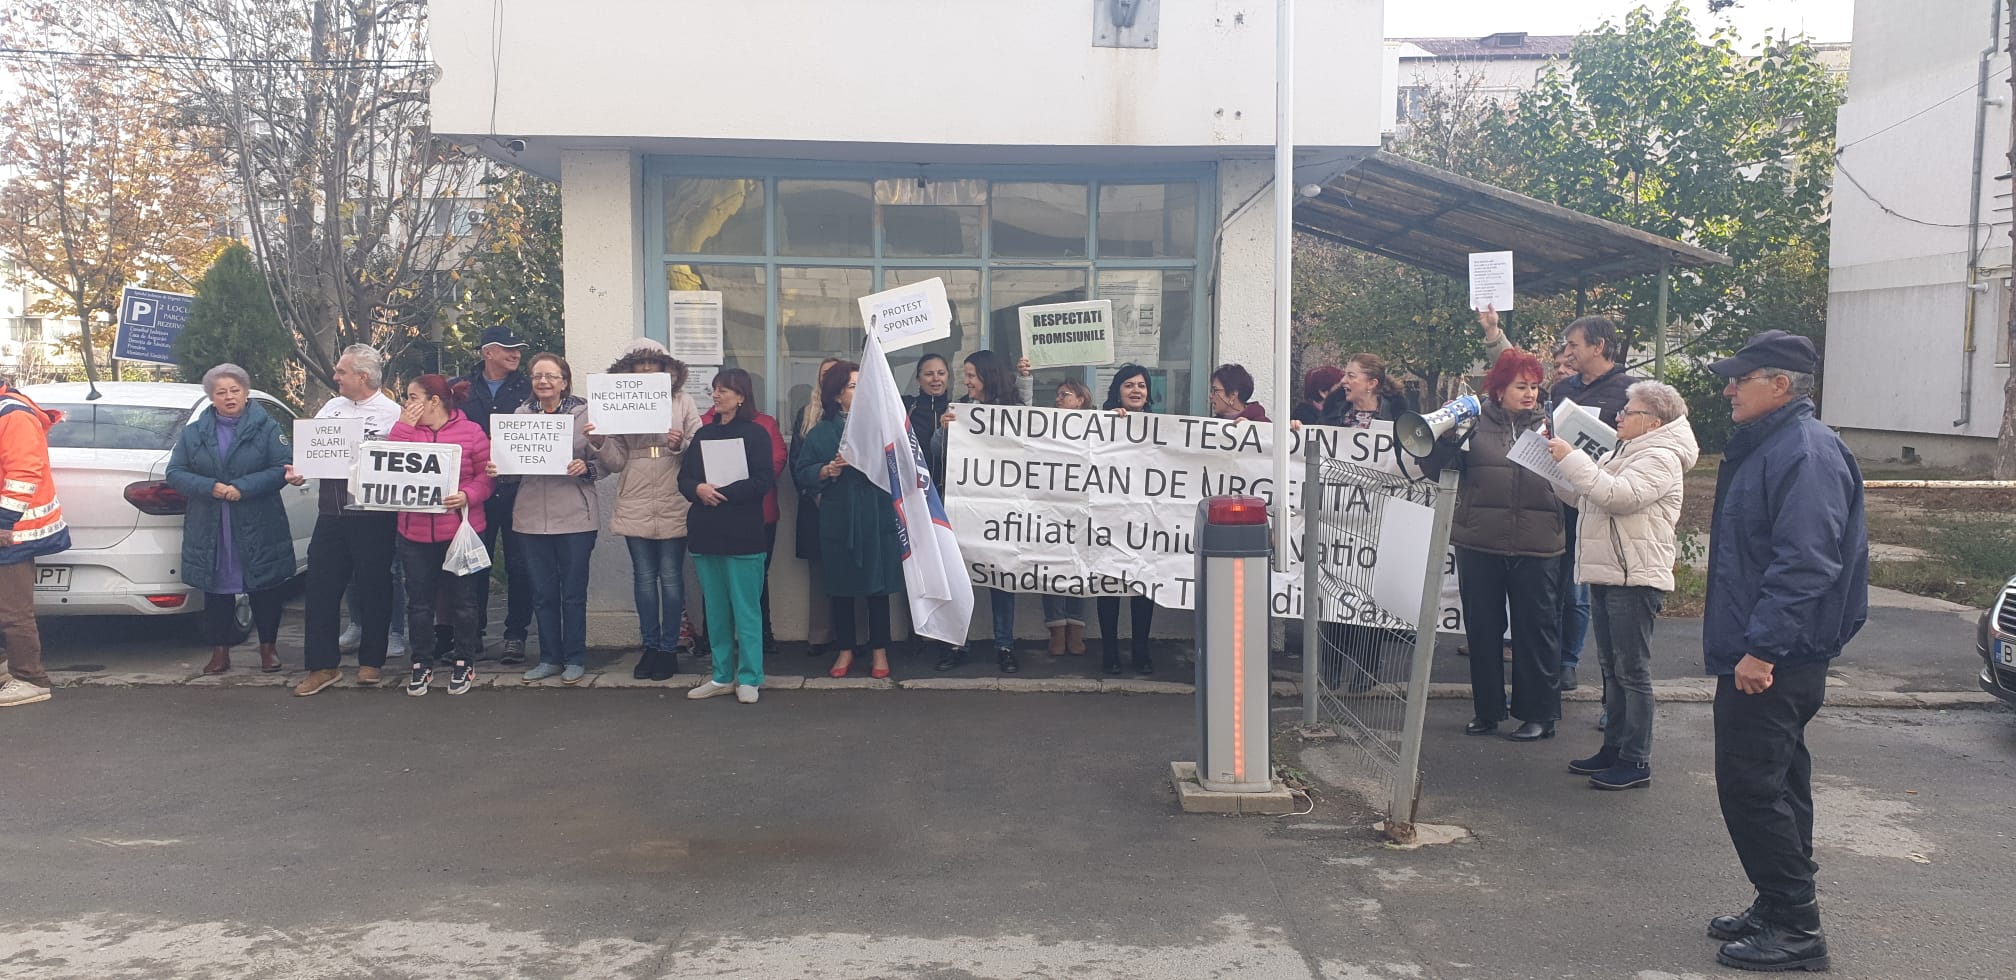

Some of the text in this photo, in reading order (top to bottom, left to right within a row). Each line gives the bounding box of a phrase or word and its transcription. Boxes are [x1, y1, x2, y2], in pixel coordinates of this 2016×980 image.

[131, 301, 152, 321] P
[882, 300, 922, 319] PROTEST
[883, 312, 928, 333] SPONTAN
[1033, 310, 1103, 328] RESPECTATI
[1032, 329, 1105, 345] PROMISIUNILE
[615, 380, 643, 389] STOP
[591, 391, 668, 400] INECHITATILOR
[602, 402, 657, 411] SALARIALE
[315, 426, 342, 435] VREM
[498, 420, 566, 430] DREPTATE SI
[969, 407, 1167, 446] SINDICATUL
[1178, 418, 1262, 454] TESA
[310, 438, 346, 447] SALARII
[503, 432, 560, 441] EGALITATE
[306, 449, 350, 459] DECENTE
[510, 443, 553, 452] PENTRU
[1573, 431, 1611, 461] TES
[370, 450, 442, 474] TESA
[519, 455, 546, 464] TESA
[956, 457, 1131, 495] JUDETEAN
[1144, 468, 1188, 499] DE
[362, 483, 443, 506] TULCEA
[983, 511, 1076, 545] afiliat
[1087, 517, 1112, 547] la
[971, 562, 1164, 601] Sindicatelor
